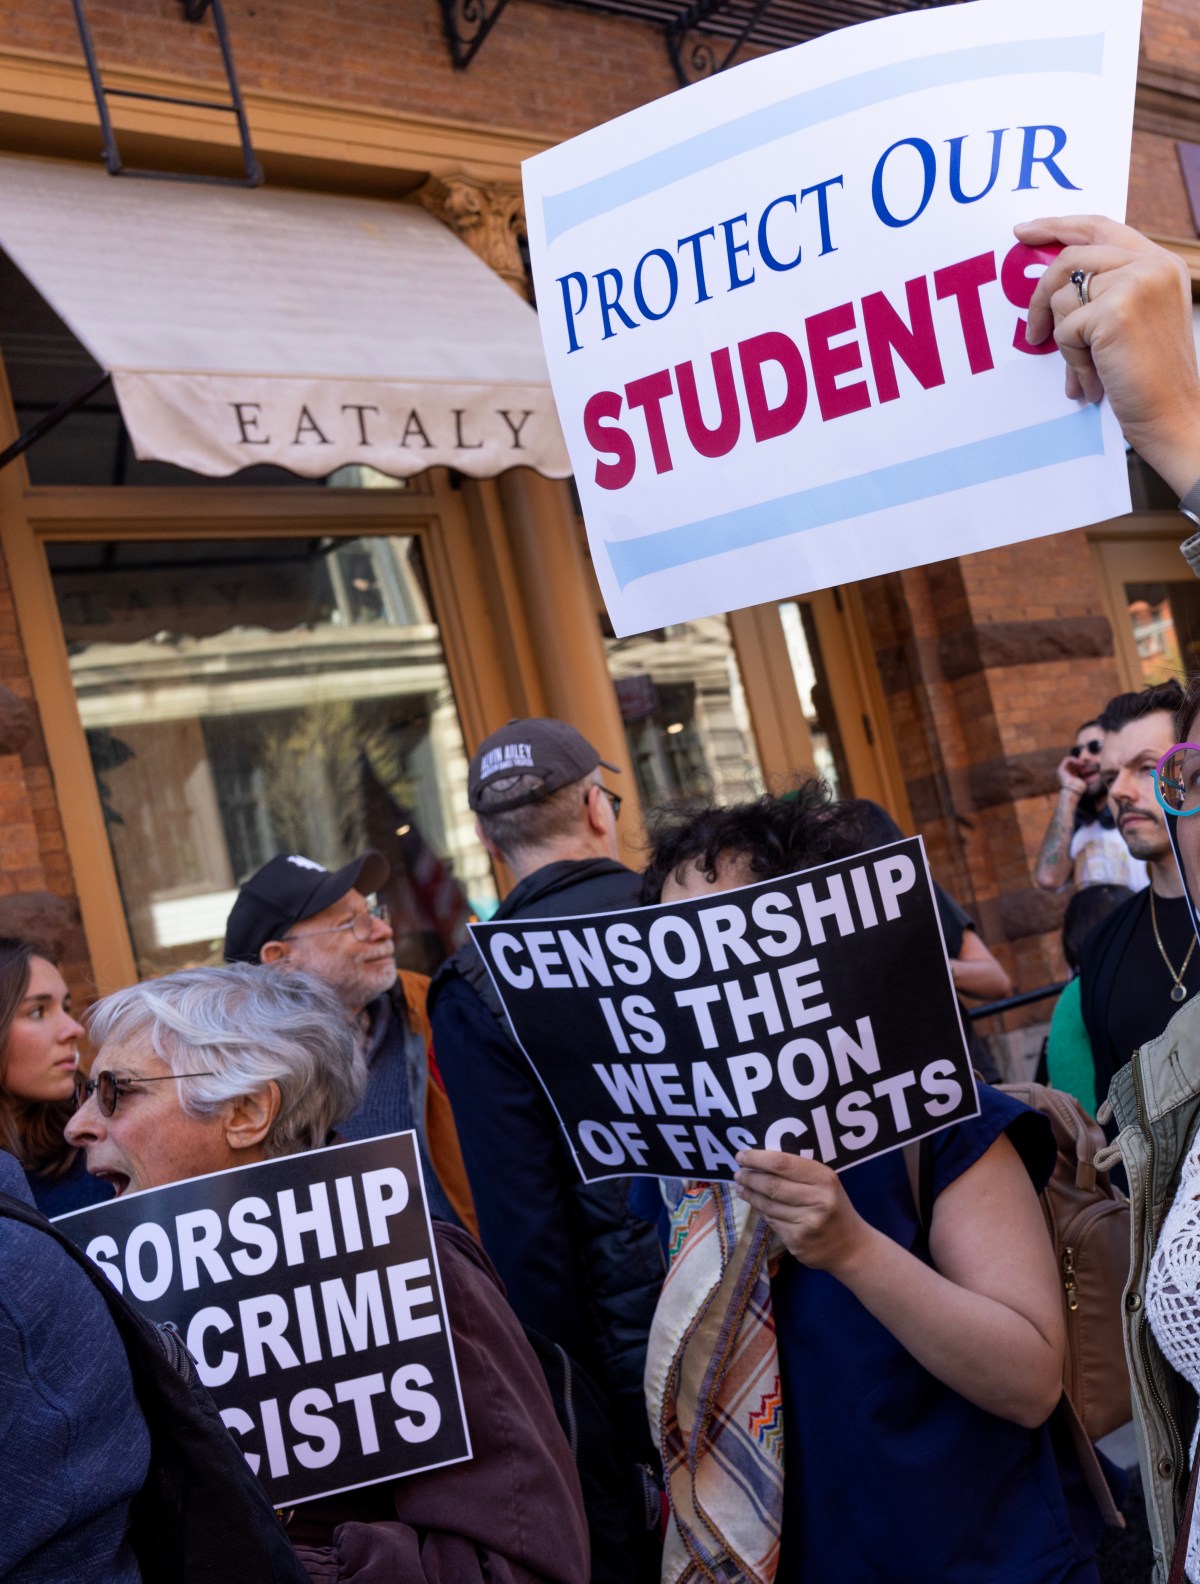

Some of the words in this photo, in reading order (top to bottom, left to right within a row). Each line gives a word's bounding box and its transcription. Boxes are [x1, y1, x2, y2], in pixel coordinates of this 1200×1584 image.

[555, 174, 844, 354] PROTECT
[870, 123, 1083, 229] OUR
[230, 402, 535, 450] EATALY
[583, 240, 1062, 490] STUDENTS
[489, 854, 917, 990] CENSORSHIP
[591, 1015, 881, 1118] WEAPON
[597, 994, 667, 1056] IS
[673, 957, 833, 1050] THE
[577, 1120, 649, 1167] OF
[656, 1058, 963, 1173] FASCISTS
[85, 1167, 409, 1302] SORSHIP
[186, 1258, 442, 1388] CRIME
